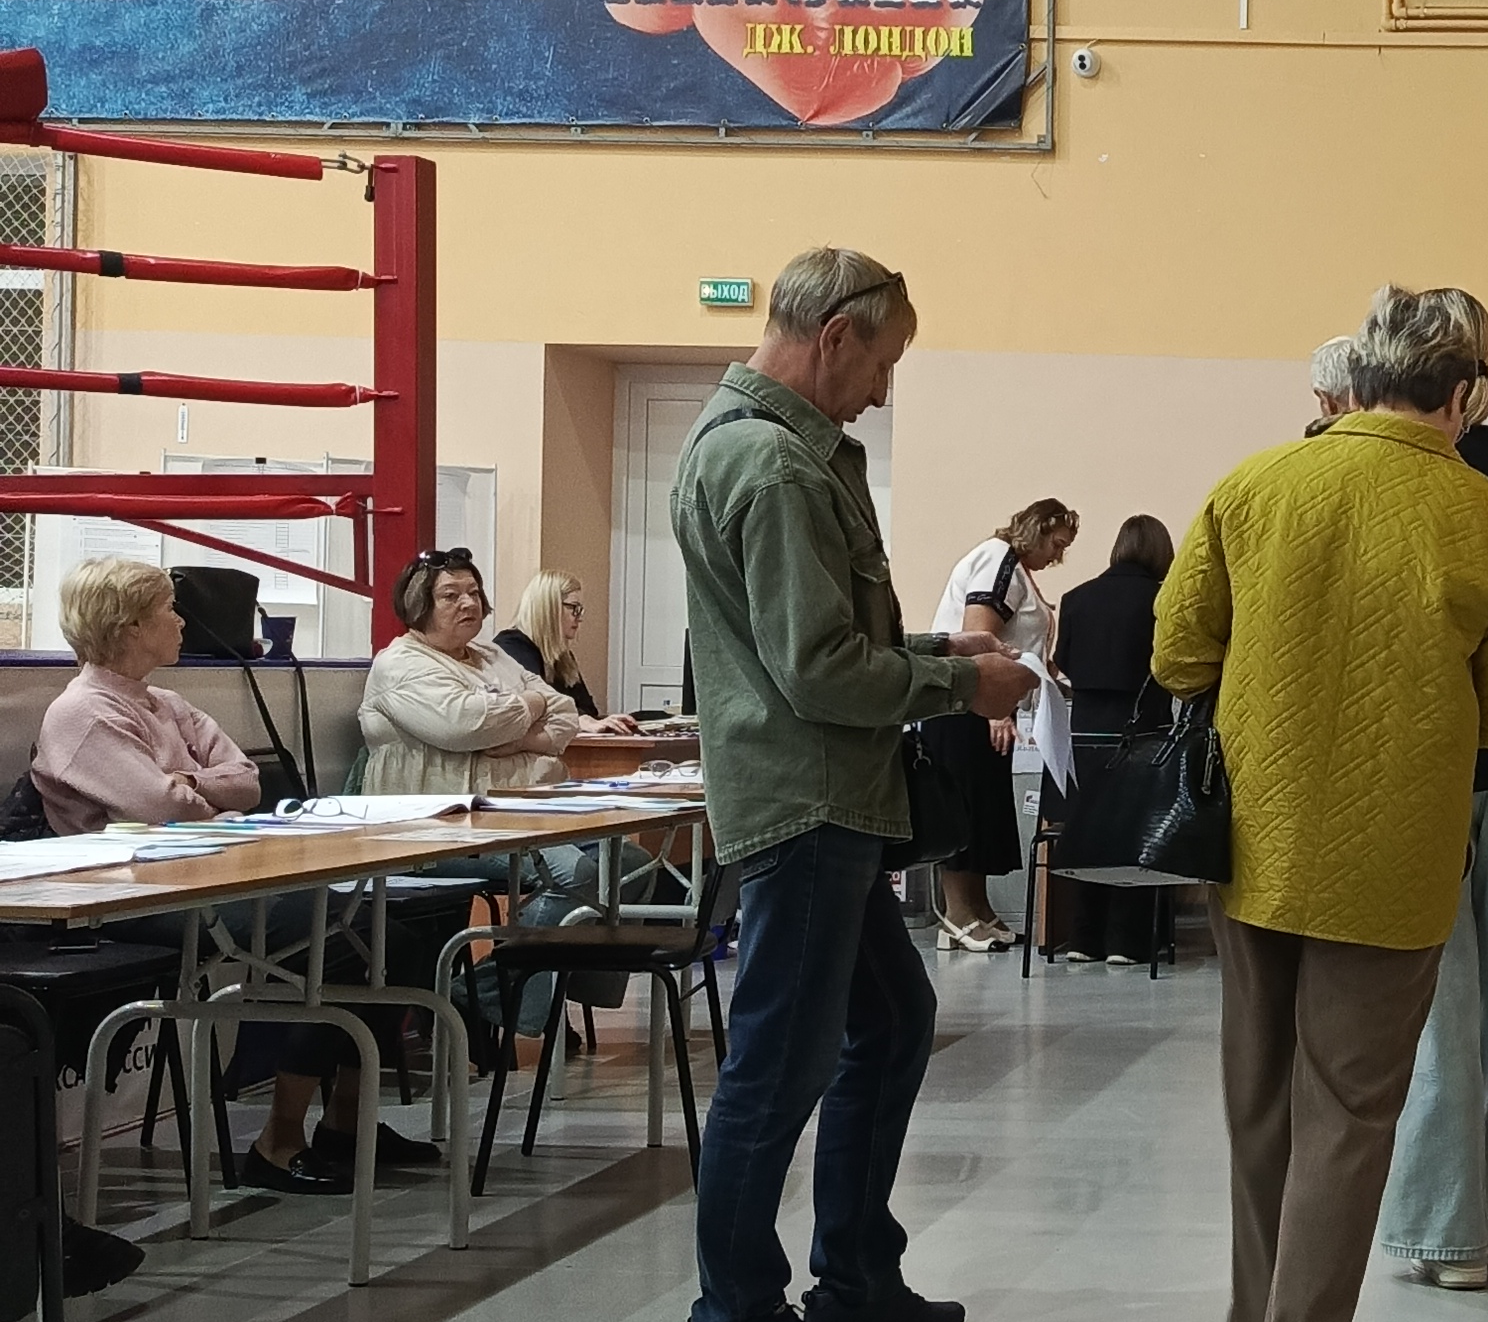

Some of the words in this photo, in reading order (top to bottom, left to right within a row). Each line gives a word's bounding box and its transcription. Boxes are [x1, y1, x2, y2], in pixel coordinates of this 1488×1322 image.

[743, 23, 814, 58] ДЖ.
[829, 24, 973, 61] ЛОНДОН
[701, 283, 748, 302] ВЫХОД
